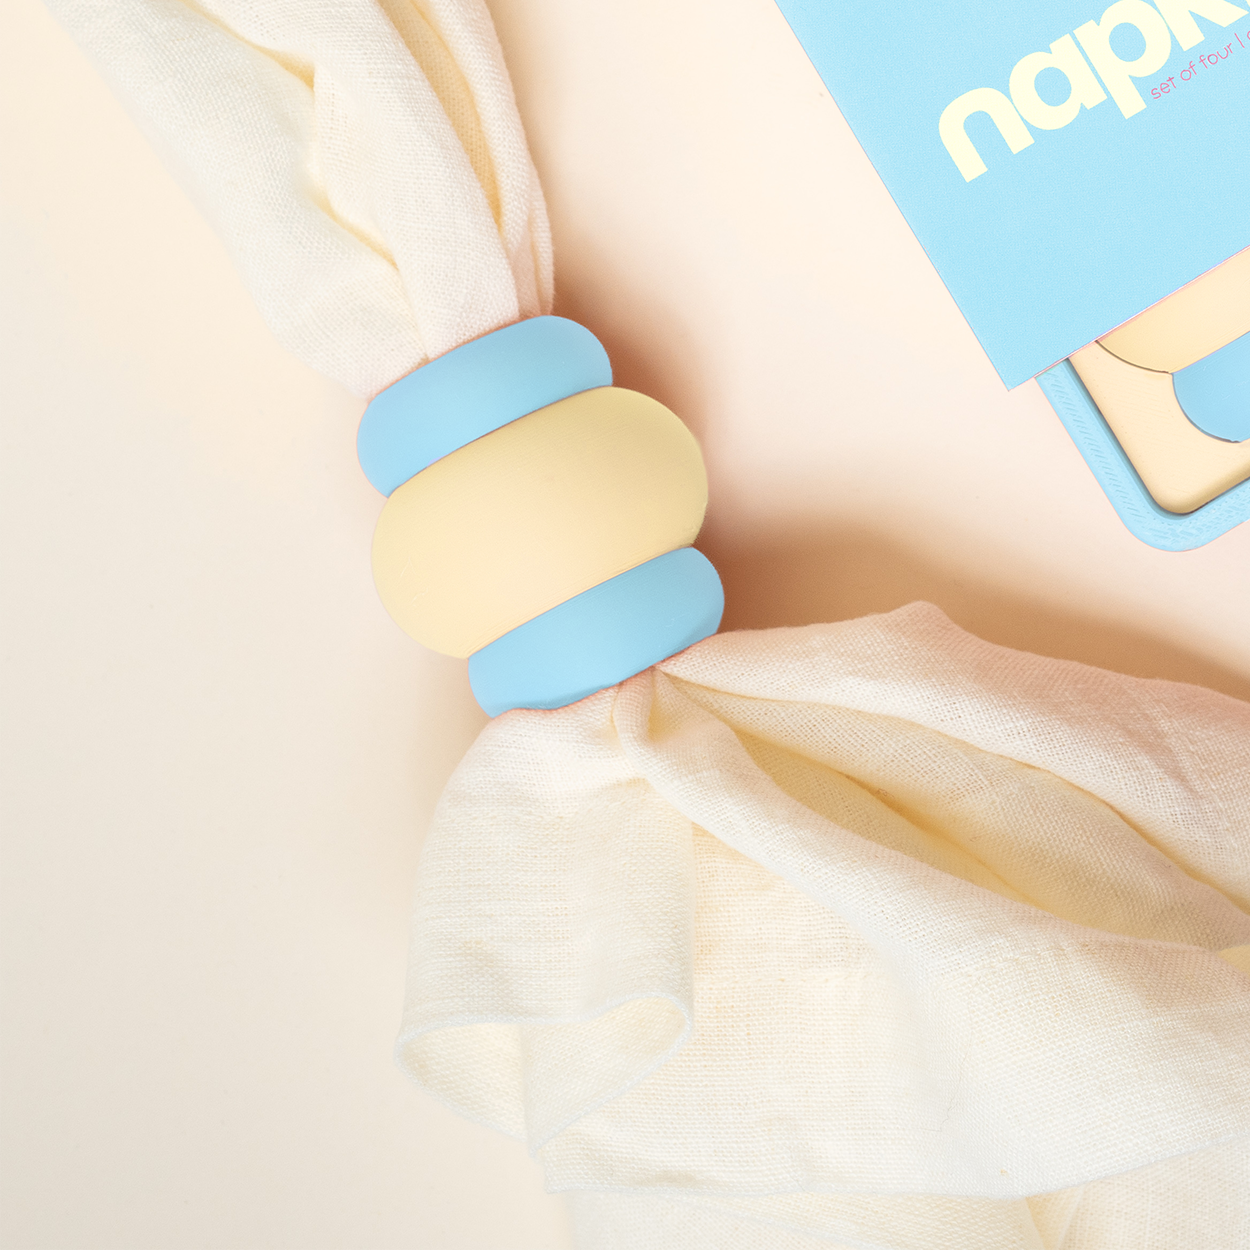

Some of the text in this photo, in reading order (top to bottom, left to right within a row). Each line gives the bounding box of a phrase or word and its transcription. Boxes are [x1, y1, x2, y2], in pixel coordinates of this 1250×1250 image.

[1150, 75, 1177, 100] set
[1180, 56, 1199, 81] of
[1198, 42, 1234, 70] four
